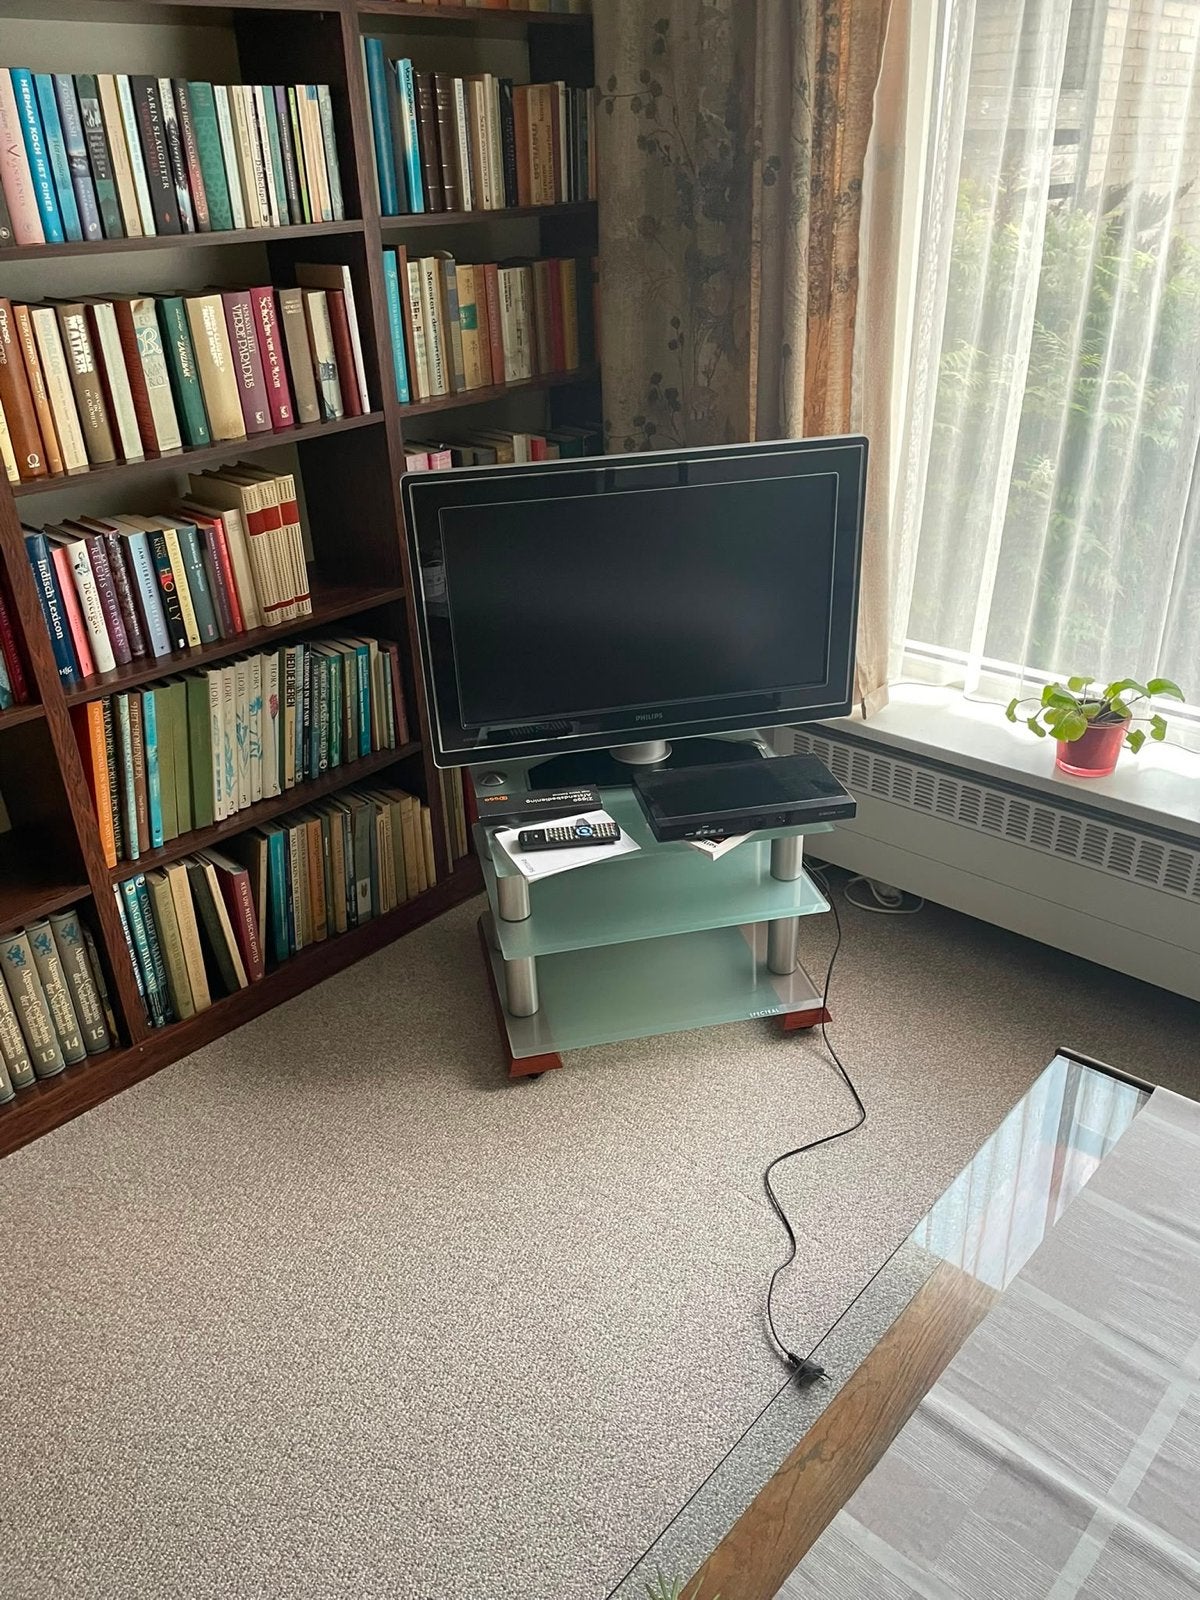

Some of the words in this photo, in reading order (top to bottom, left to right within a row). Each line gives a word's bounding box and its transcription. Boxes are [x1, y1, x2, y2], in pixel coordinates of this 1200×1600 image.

[20, 78, 34, 123] HERMAN
[177, 87, 187, 109] MARY
[29, 125, 41, 154] KOCH
[145, 86, 158, 122] KARIN
[152, 125, 170, 188] SLAUGHTER
[181, 110, 193, 145] HIGGINS
[36, 158, 46, 179] HET
[187, 145, 197, 168] CLARK
[40, 180, 52, 212] DINER
[254, 158, 267, 205] Dubbelspel
[424, 270, 437, 316] Meesters
[0, 307, 13, 344] Chinese
[229, 303, 247, 339] VERRE
[430, 317, 438, 332] der
[63, 314, 88, 374] MAILER
[246, 335, 257, 354] HET
[268, 351, 278, 365] de
[235, 339, 256, 389] PARADIJS
[431, 335, 445, 389] vertelkunst
[136, 546, 144, 559] JAN
[150, 537, 165, 559] KING
[35, 558, 56, 598] Indisch
[82, 581, 94, 595] De
[139, 561, 153, 598] SIEBELINK
[88, 546, 109, 588] REICHS
[102, 589, 128, 646] GEBROKEN
[157, 567, 183, 622] HOLLY
[45, 598, 67, 639] Lexicon
[81, 595, 103, 635] overgave
[285, 652, 295, 668] RED
[285, 669, 295, 679] DE
[302, 651, 310, 688] NEUSHOORNS
[101, 696, 109, 708] DE
[129, 701, 140, 723] HET
[635, 712, 663, 721] PHILIPS
[102, 710, 115, 755] WONDERE
[130, 725, 145, 779] BOMENBOEK
[106, 757, 118, 792] WERELD
[272, 784, 278, 792] 5
[110, 794, 120, 811] DER
[217, 807, 222, 816] 1
[228, 800, 235, 811] 2
[241, 794, 247, 804] 3
[112, 813, 123, 847] NATUUR
[239, 881, 248, 895] KEN
[242, 896, 249, 906] UW
[137, 893, 159, 939] ONGEREPT
[242, 907, 257, 940] MEDISCHE
[125, 900, 148, 945] ONGEREPT
[137, 946, 161, 990] THAILAND
[249, 940, 260, 962] OPTIES
[46, 981, 56, 994] der
[46, 955, 64, 989] Algemene
[56, 988, 76, 1031] Geschiedenis
[73, 971, 83, 983] der
[73, 946, 90, 979] Algemene
[83, 977, 101, 1021] Geschiedenis
[20, 993, 30, 1006] der
[20, 967, 38, 1002] Algemene
[31, 1000, 52, 1044] Geschiedenis
[50, 993, 68, 1035] Nederlanden
[76, 983, 94, 1025] Nederlanden
[4, 1010, 24, 1055] Geschiedenis
[24, 1005, 42, 1047] Nederlanden
[90, 1026, 105, 1040] 15
[41, 1049, 56, 1063] 13
[64, 1036, 79, 1050] 14
[13, 1060, 29, 1075] 12
